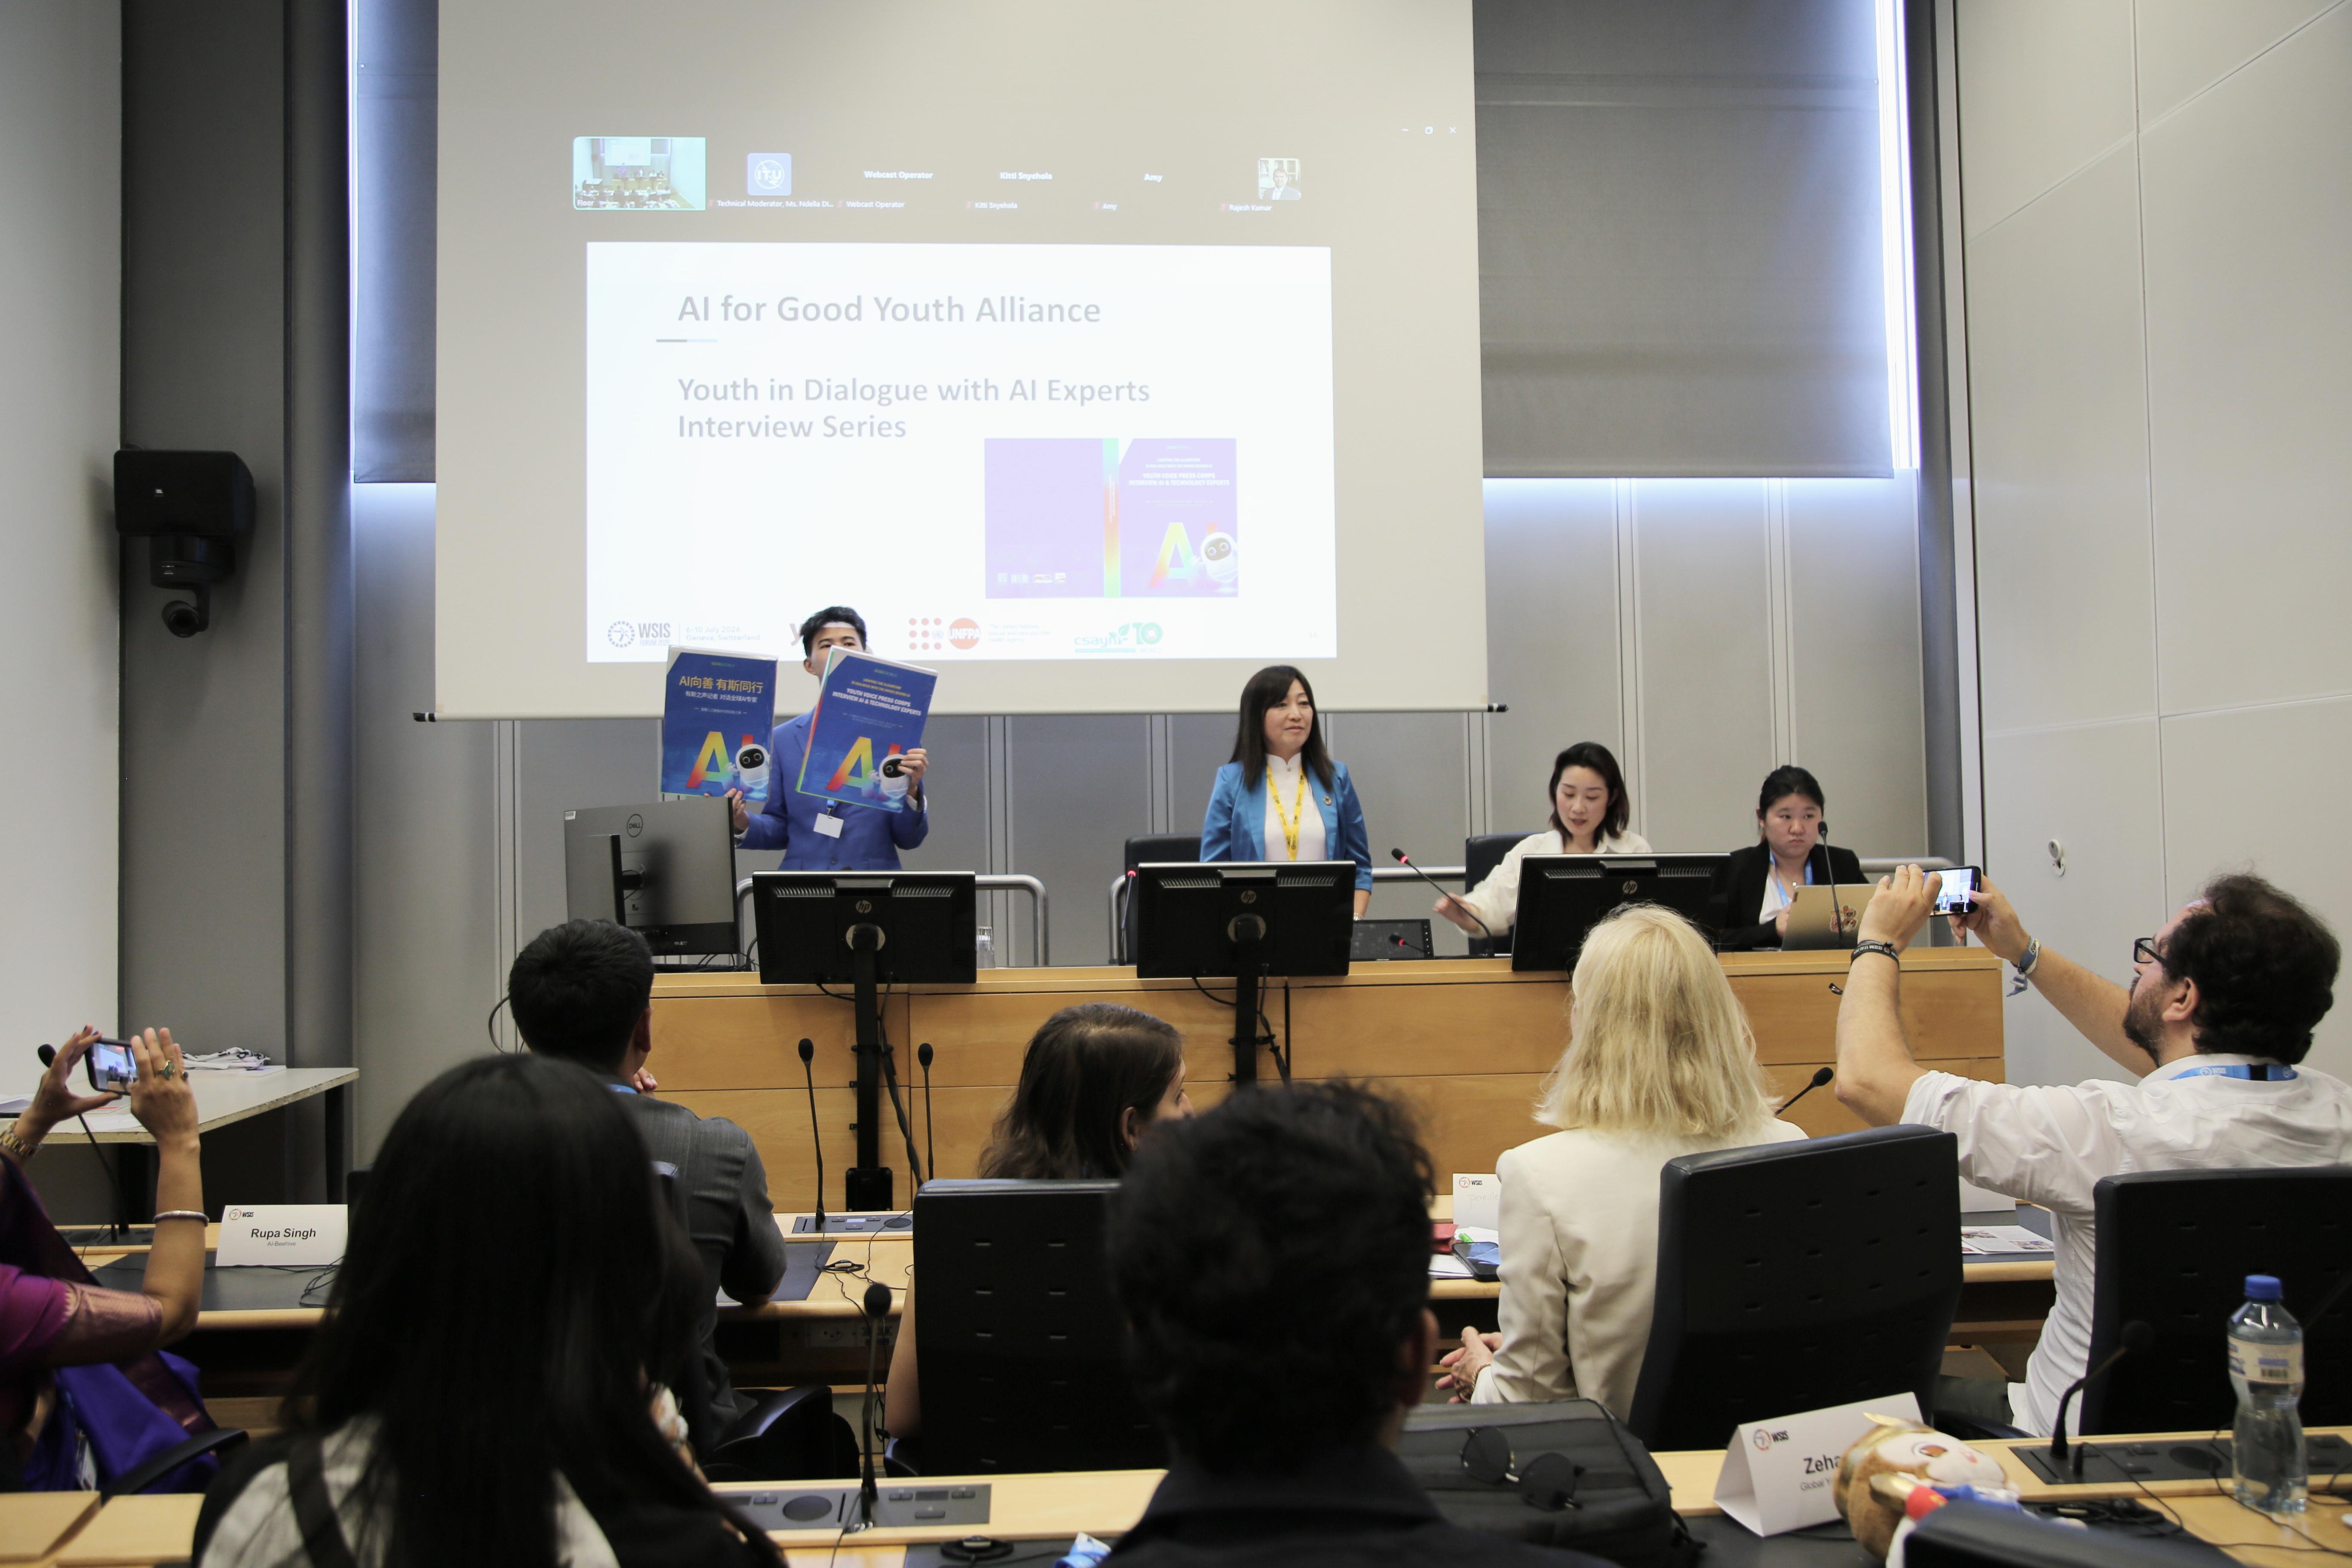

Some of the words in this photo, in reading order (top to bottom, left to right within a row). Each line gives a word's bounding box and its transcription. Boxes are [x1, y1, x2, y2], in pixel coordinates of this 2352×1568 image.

[757, 169, 782, 181] ITU
[864, 170, 897, 178] Webcast
[898, 171, 934, 180] Operator
[1144, 173, 1163, 183] Amy
[1102, 203, 1118, 211] Amy
[677, 297, 709, 322] AI
[722, 296, 766, 322] for
[778, 296, 862, 322] Good
[874, 296, 964, 322] Youth
[976, 296, 1101, 322] Alliance
[678, 378, 758, 400] Youth
[769, 379, 793, 400] in
[805, 378, 928, 406] Dialogue
[937, 378, 998, 401] with
[1010, 380, 1036, 401] AI
[1049, 380, 1150, 407] Experts
[679, 415, 813, 437] Interview
[823, 415, 906, 438] Series
[638, 623, 671, 638] WSIS
[705, 626, 720, 634] July
[949, 628, 981, 640] UNFPA
[679, 675, 714, 689] AI向善
[716, 678, 763, 694] 有斯同行
[847, 688, 864, 696] YOUTH
[864, 691, 878, 699] VOICE
[1624, 881, 1636, 894] hp
[1242, 891, 1255, 903] hp
[858, 900, 870, 913] hp
[251, 1228, 280, 1240] Rupa
[283, 1228, 316, 1240] Singh
[1771, 1430, 1789, 1442] WSIS
[1800, 1478, 1824, 1491] Global
